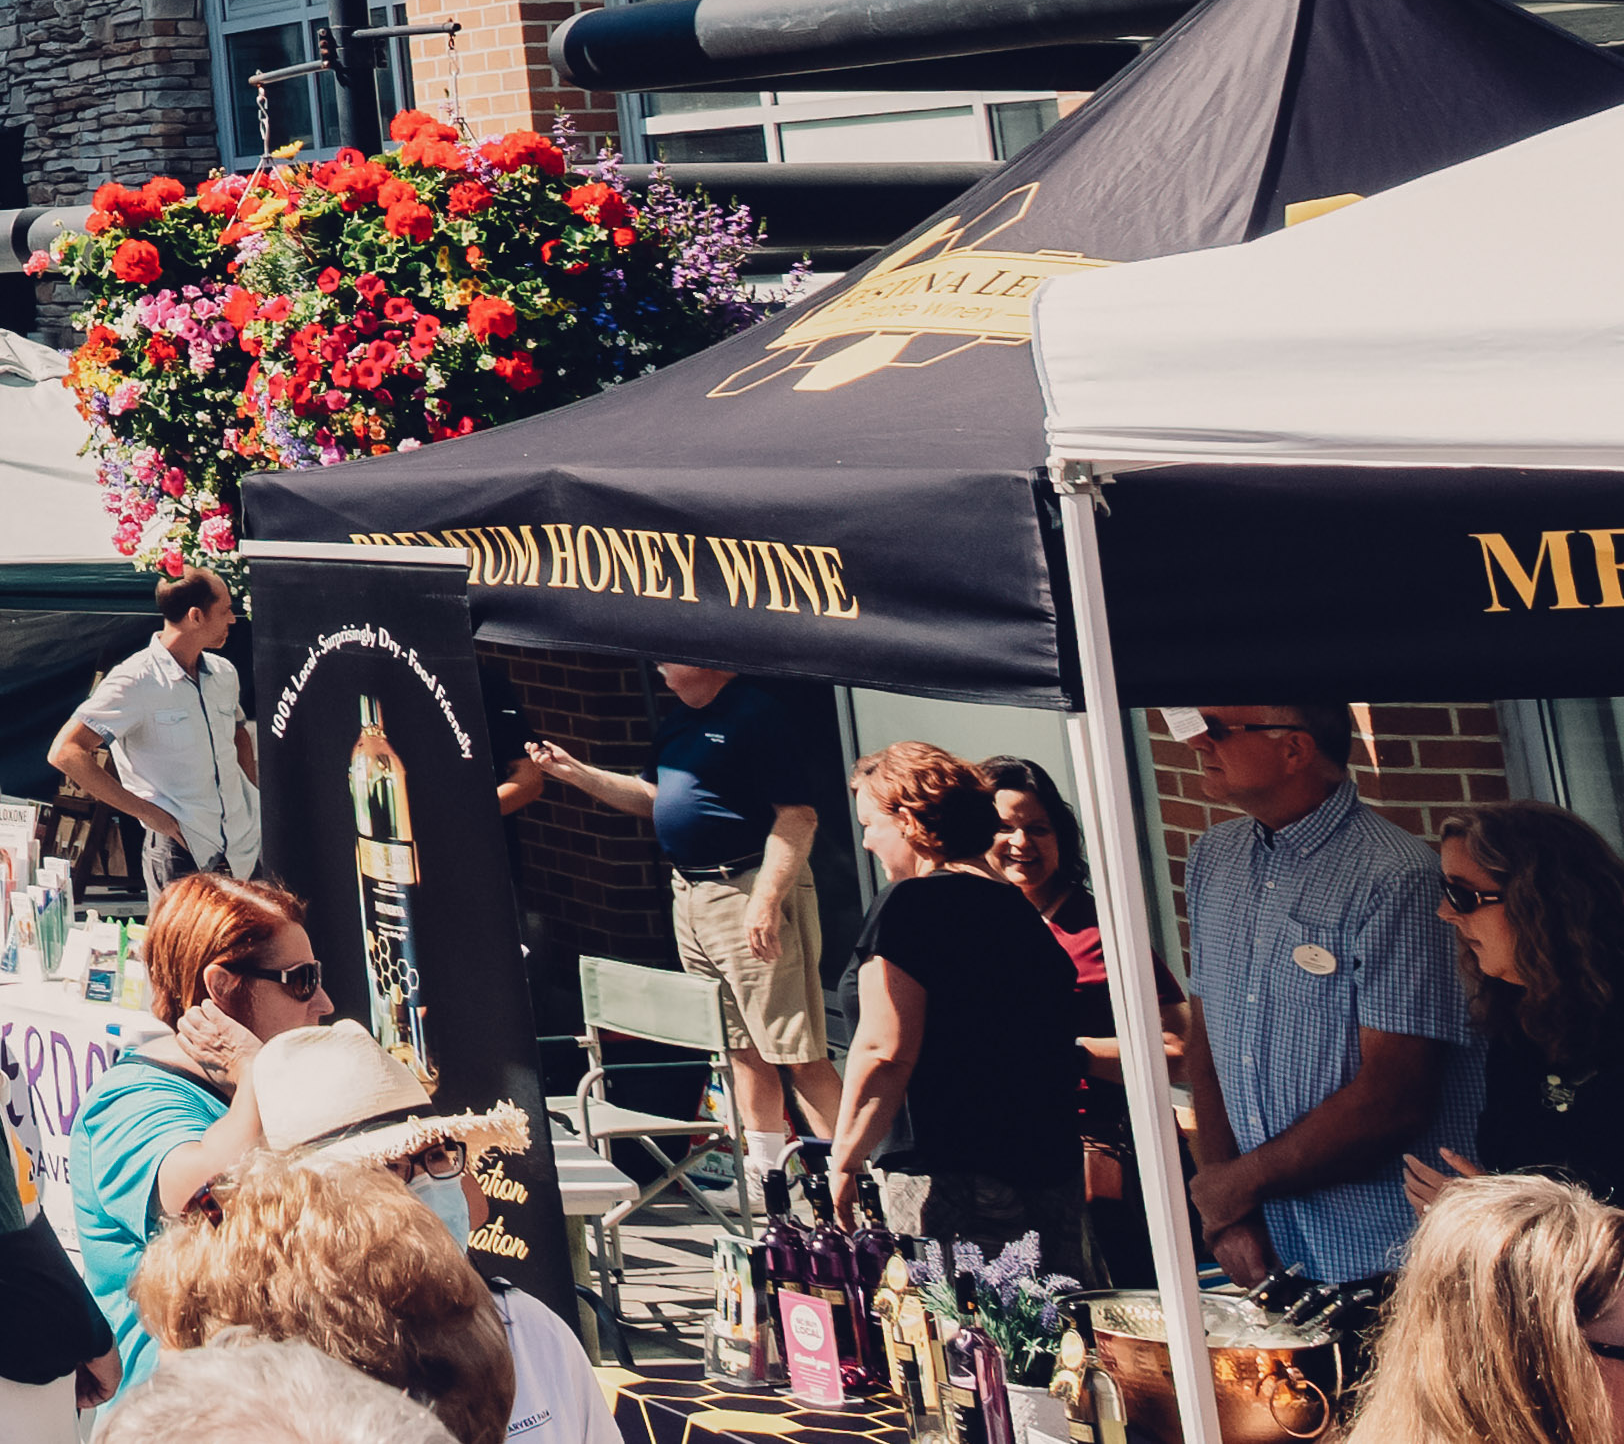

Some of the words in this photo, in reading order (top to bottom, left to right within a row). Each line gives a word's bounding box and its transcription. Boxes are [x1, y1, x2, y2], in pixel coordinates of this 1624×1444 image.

[541, 523, 701, 602] HONEY
[705, 536, 860, 620] WINE
[271, 686, 298, 739] 100%
[290, 646, 319, 693] Local
[318, 622, 377, 655] Surprisingly
[378, 627, 402, 659] Dry
[407, 648, 437, 692] Food
[434, 683, 473, 759] Friendly
